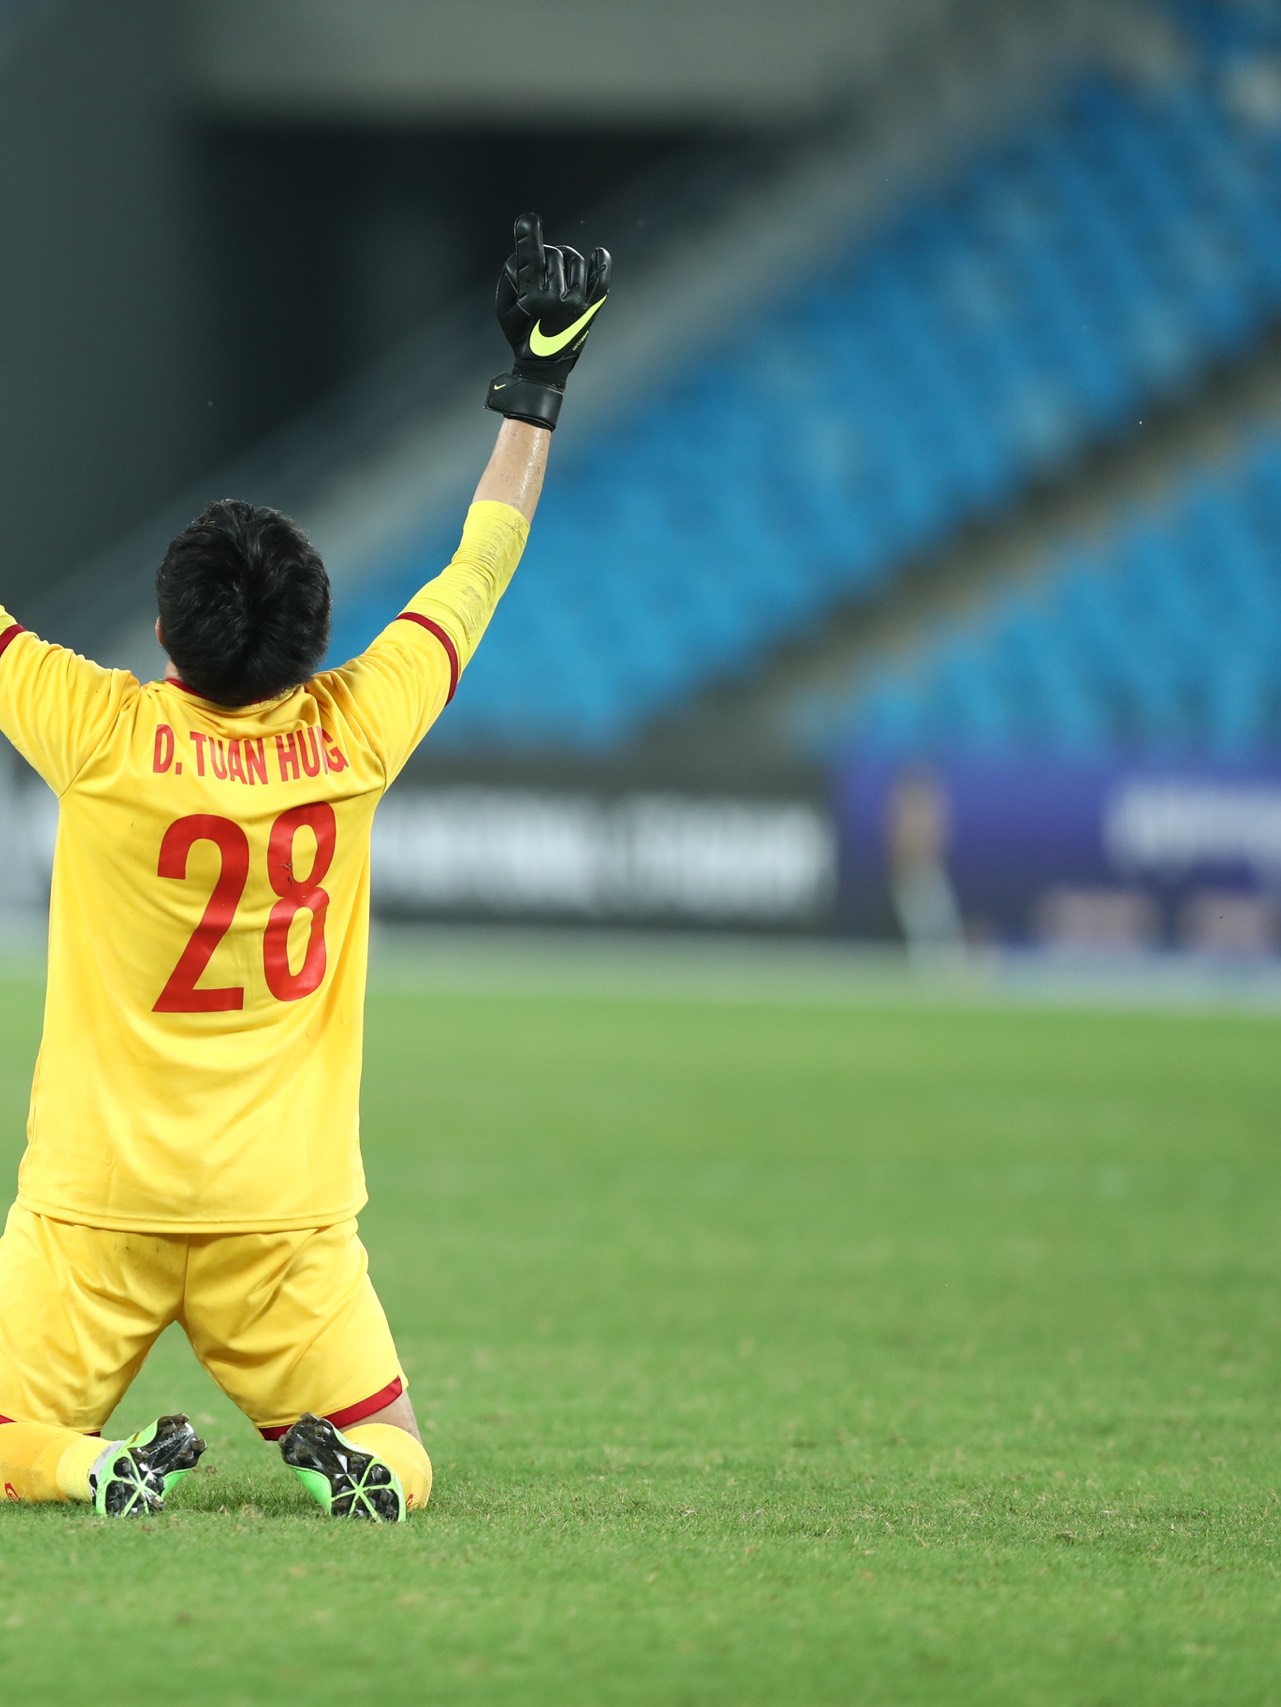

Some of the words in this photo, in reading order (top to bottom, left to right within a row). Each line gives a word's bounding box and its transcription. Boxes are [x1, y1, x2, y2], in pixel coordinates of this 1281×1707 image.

[152, 724, 182, 775] D.
[190, 731, 268, 786] TUAN
[151, 800, 337, 1014] 28
